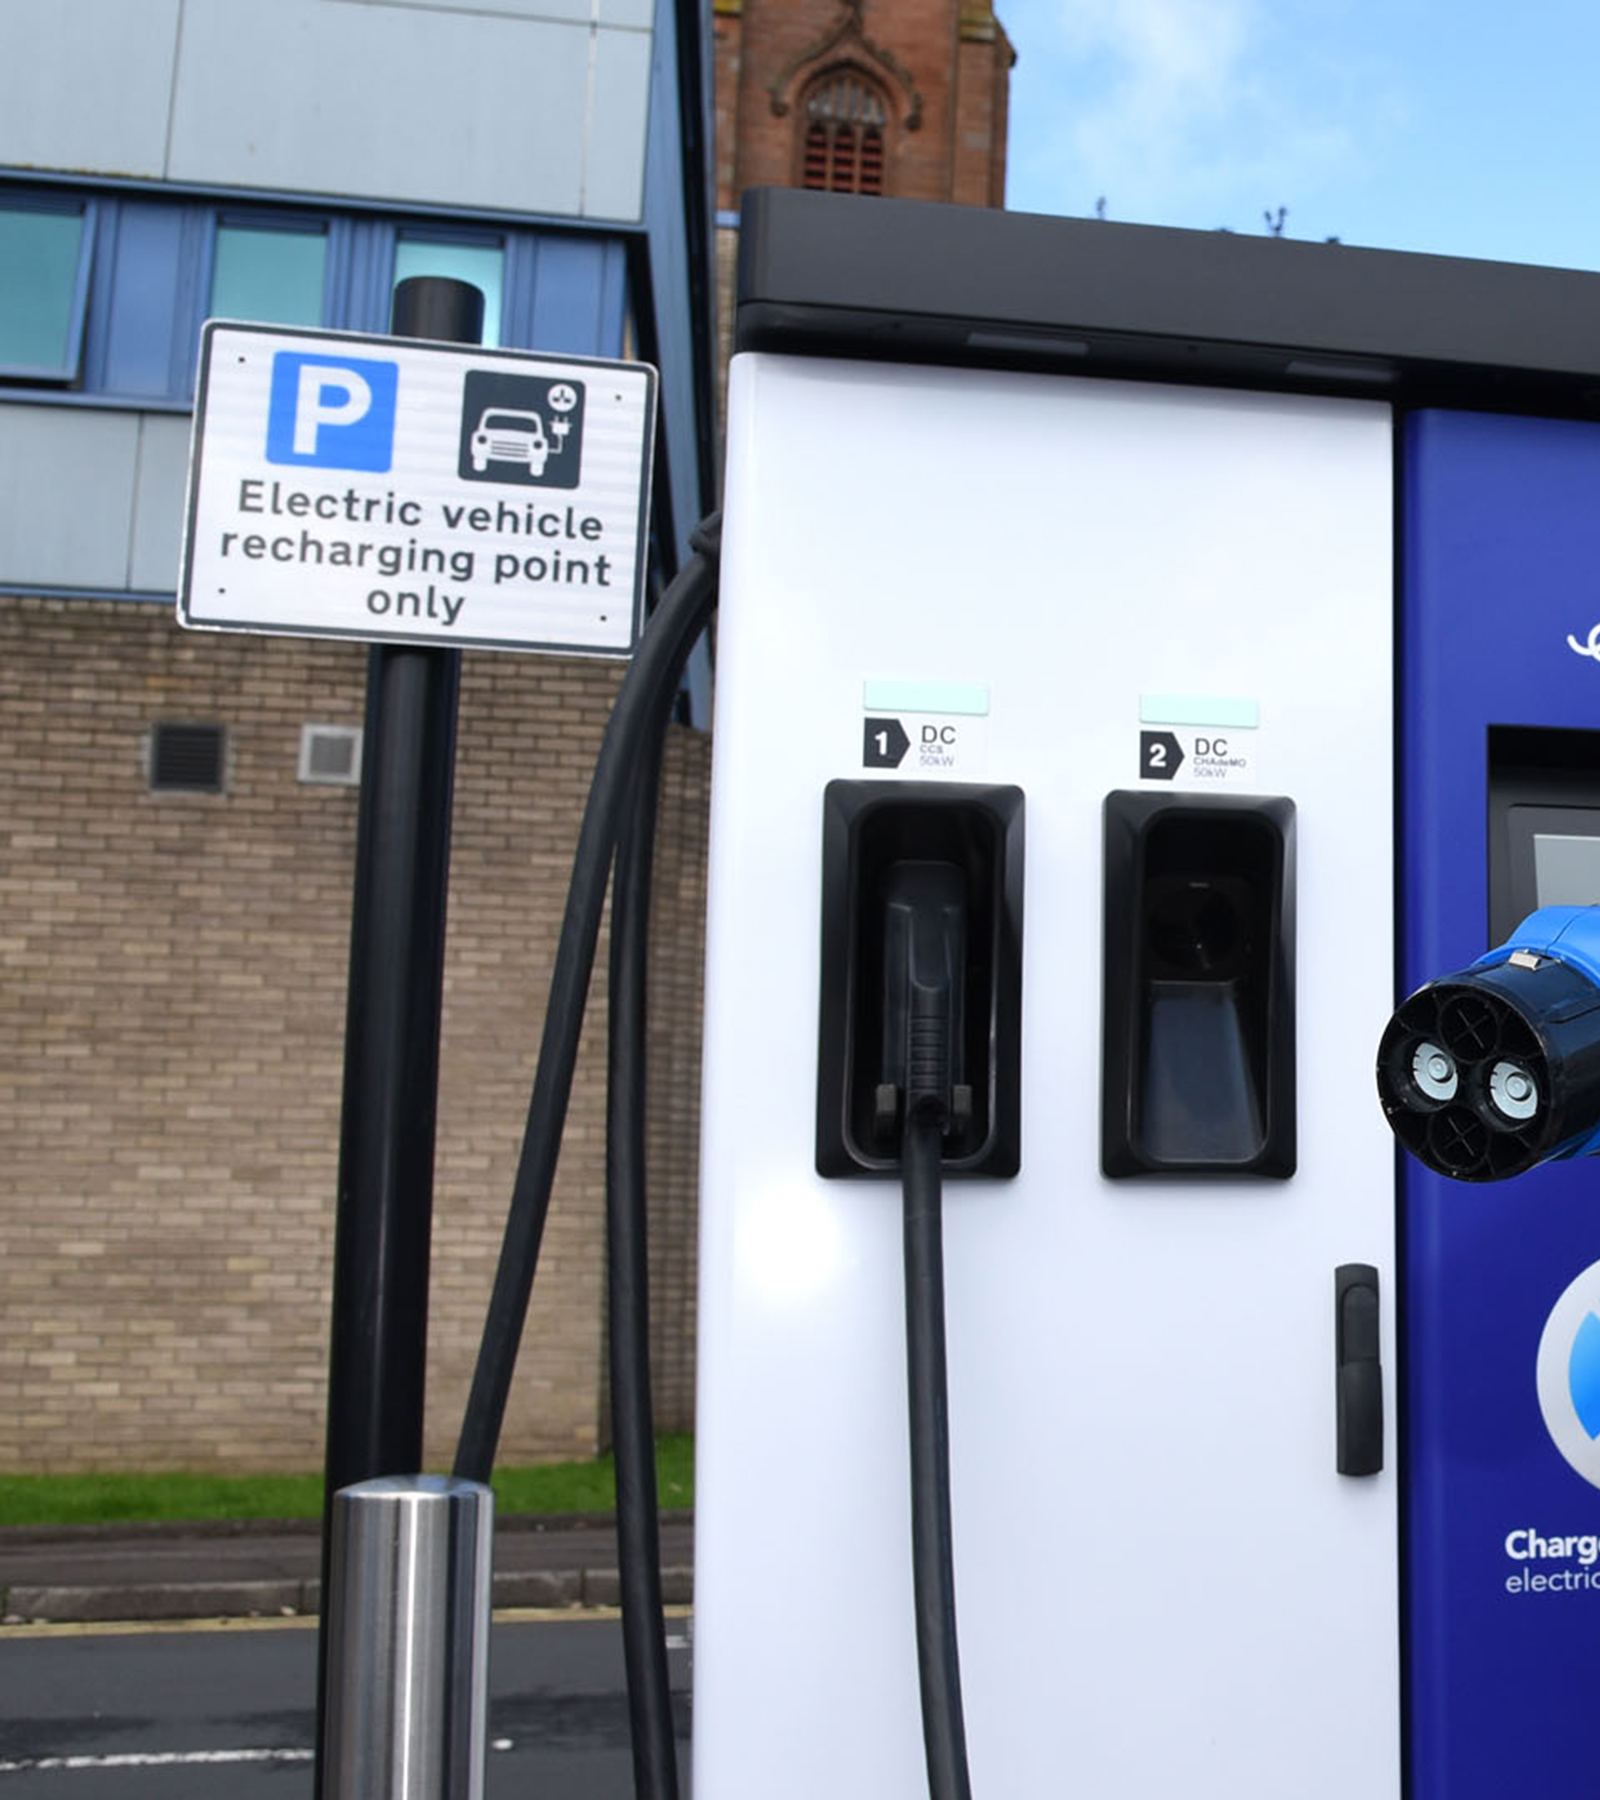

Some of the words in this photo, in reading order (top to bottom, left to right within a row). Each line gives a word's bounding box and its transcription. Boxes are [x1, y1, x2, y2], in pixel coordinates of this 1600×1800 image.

[293, 365, 372, 455] P
[238, 479, 422, 526] Electric
[442, 501, 603, 541] vehicle
[221, 531, 475, 579] recharging
[494, 547, 611, 586] point
[367, 586, 465, 625] only
[875, 731, 888, 755] 1
[922, 725, 956, 744] DC
[1149, 743, 1167, 767] 2
[1195, 738, 1228, 757] DC
